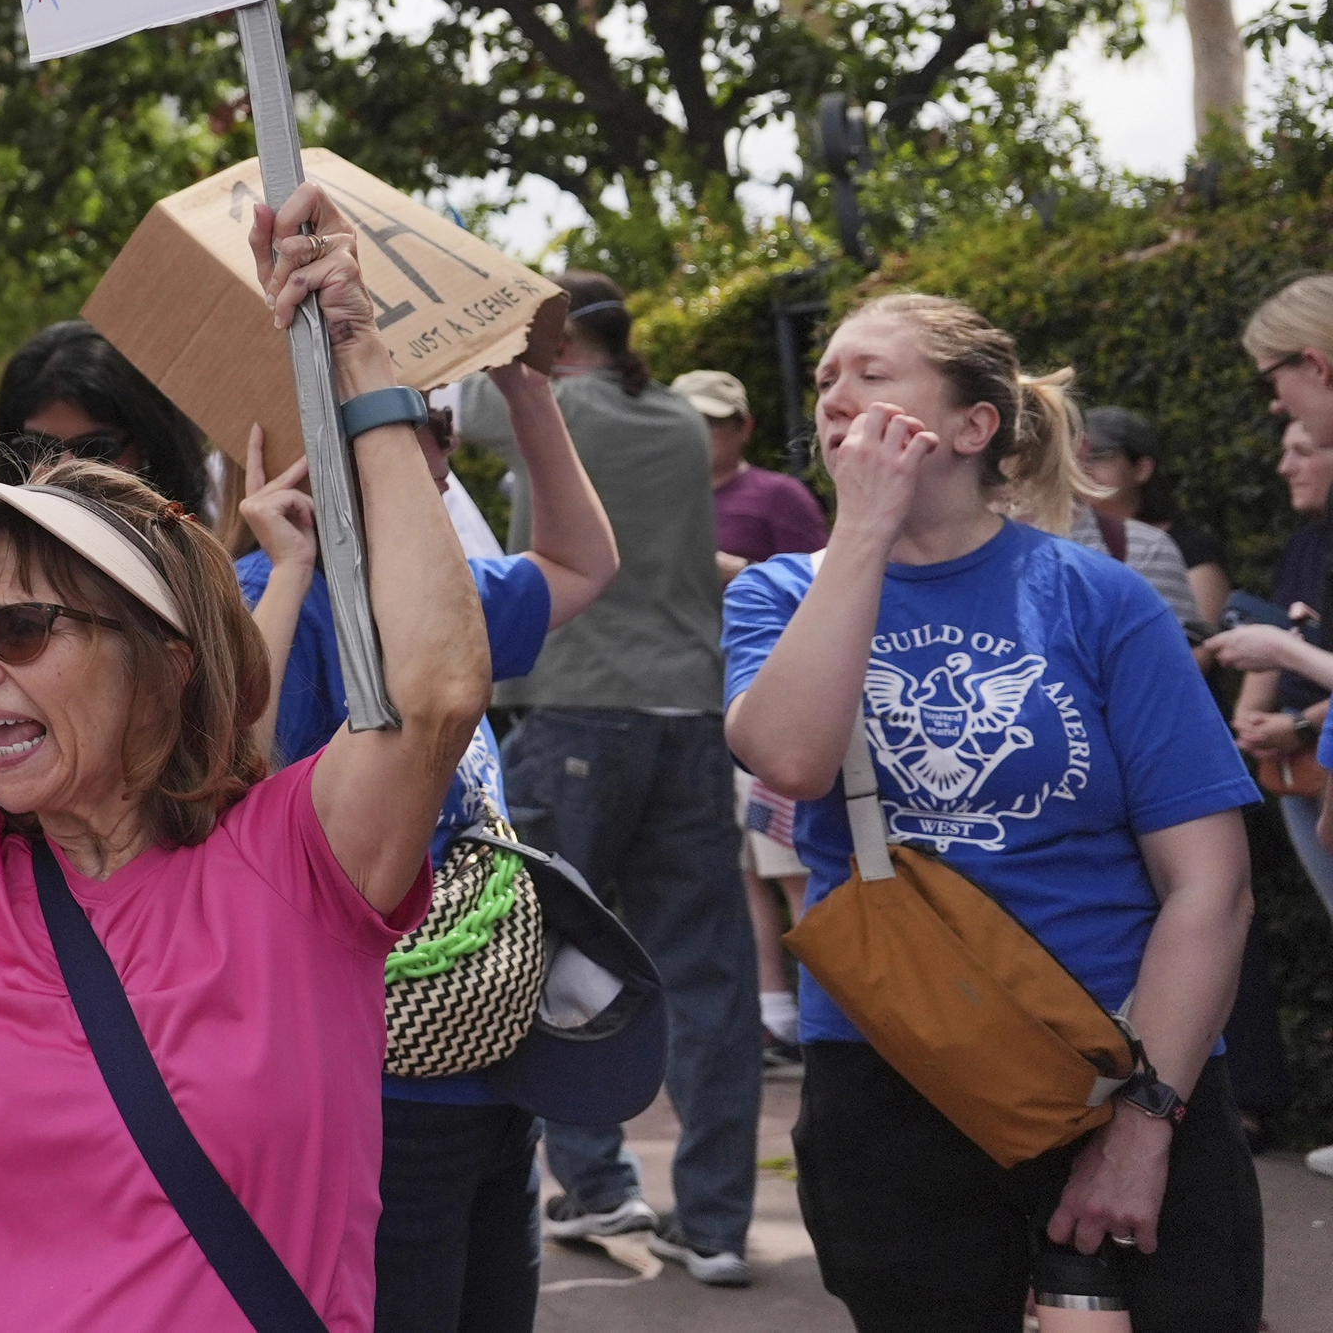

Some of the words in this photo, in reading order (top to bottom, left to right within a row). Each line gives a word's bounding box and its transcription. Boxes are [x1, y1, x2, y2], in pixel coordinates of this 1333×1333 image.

[407, 326, 452, 359] JUST
[444, 317, 474, 338] A
[462, 285, 522, 327] SCENE
[870, 624, 965, 654] GUILD
[970, 631, 1017, 658] OF
[1039, 680, 1091, 802] AMERICA
[919, 817, 975, 837] WEST
